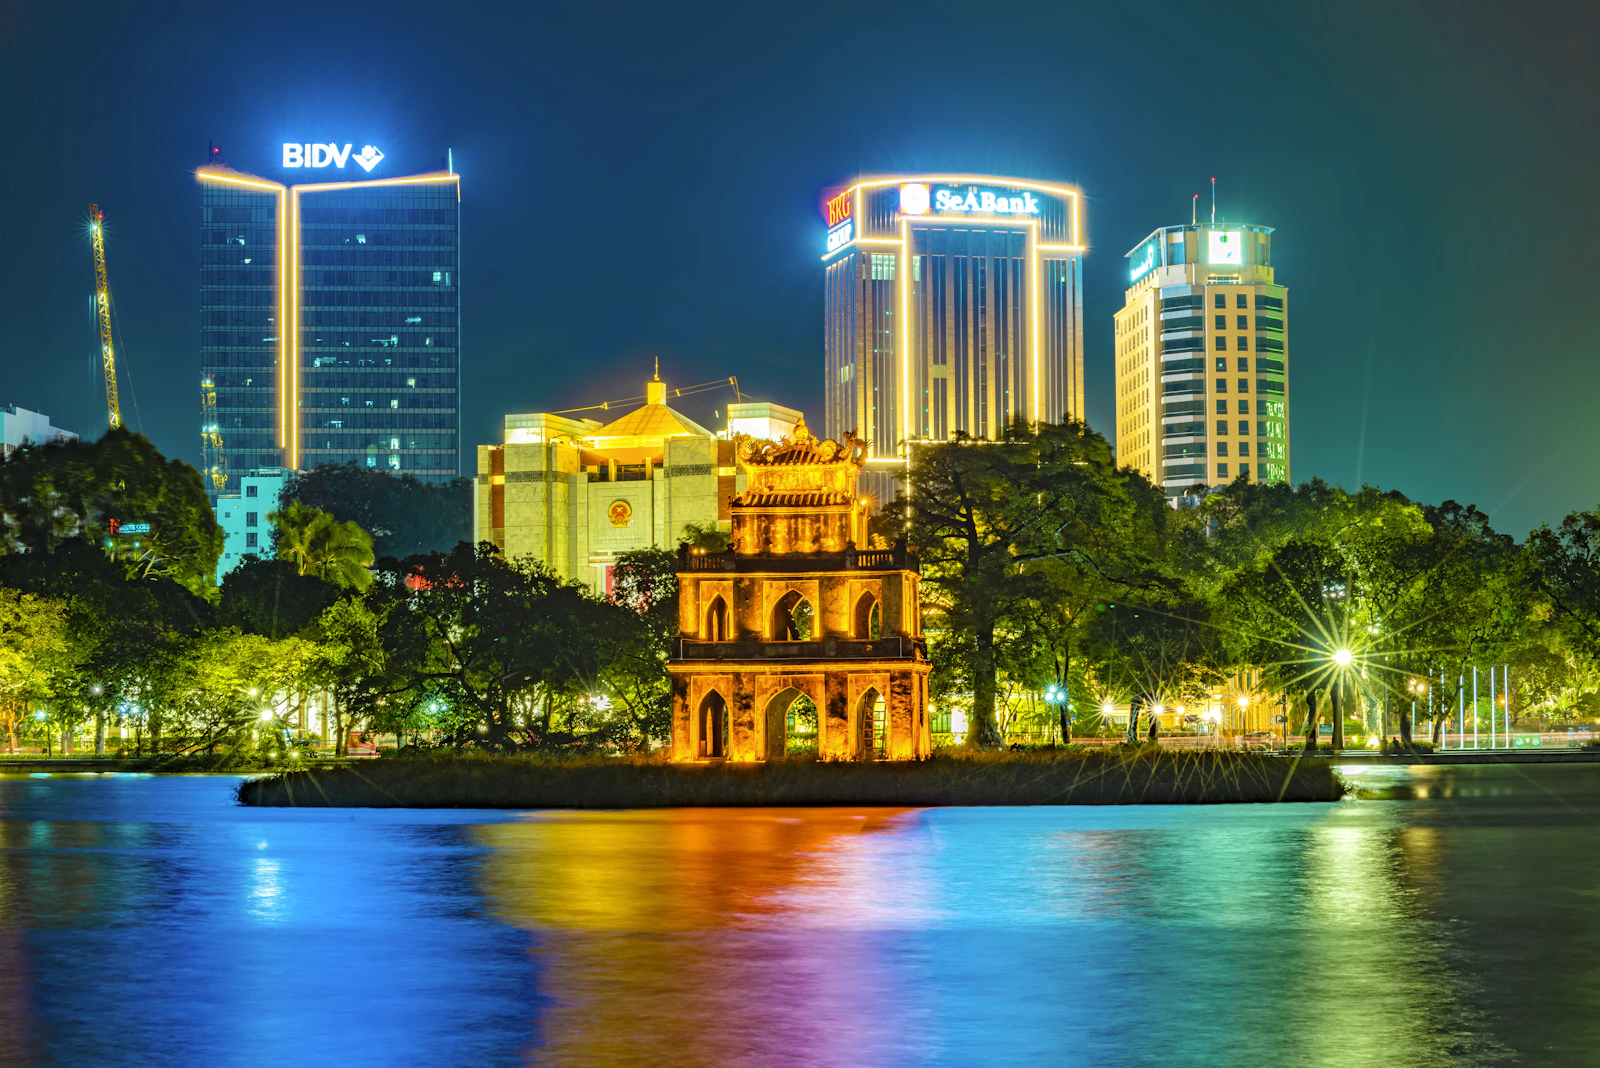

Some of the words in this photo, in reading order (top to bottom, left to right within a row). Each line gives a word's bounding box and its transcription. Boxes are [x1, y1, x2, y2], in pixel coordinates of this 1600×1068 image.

[283, 143, 352, 168] BIDV
[829, 191, 851, 227] BRG
[935, 190, 1039, 213] SeABank
